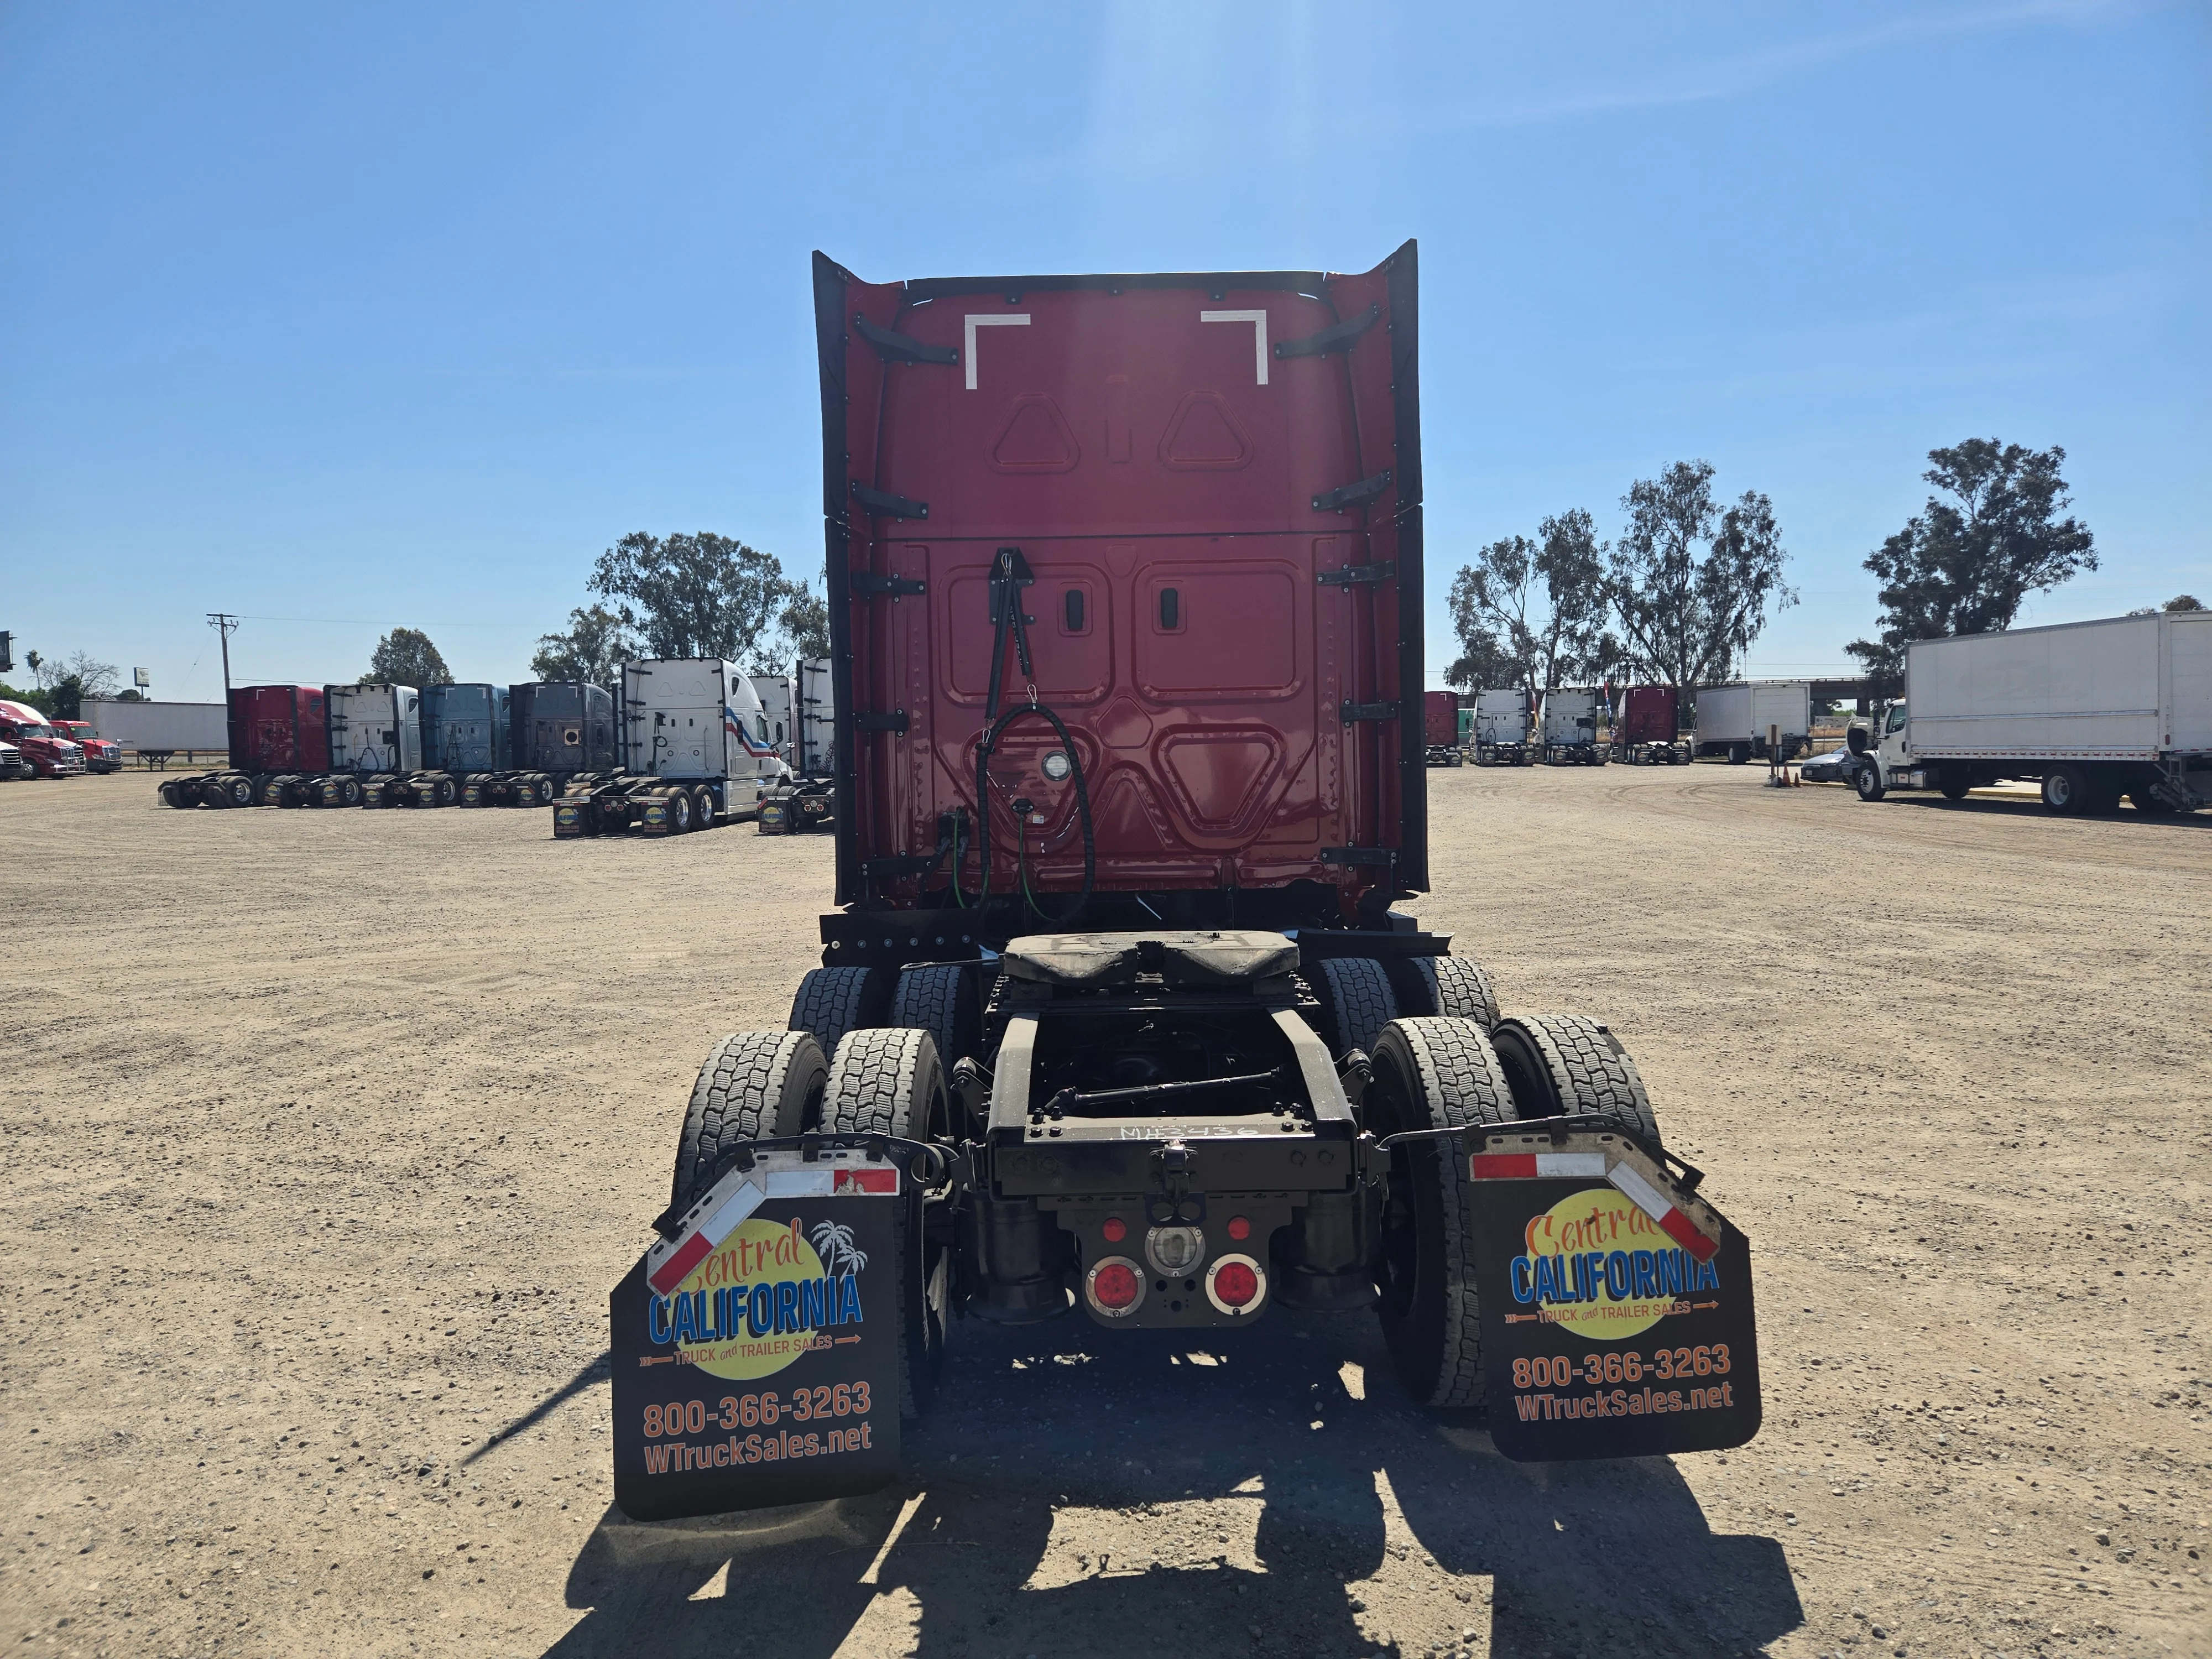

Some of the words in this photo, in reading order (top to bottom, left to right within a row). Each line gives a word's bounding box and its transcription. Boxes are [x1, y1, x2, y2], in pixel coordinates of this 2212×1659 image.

[1525, 1206, 1661, 1258] Centra
[1511, 1248, 1720, 1303] CALIFORNIA
[649, 1274, 863, 1345] CALIFORNIA
[1536, 1309, 1578, 1324] TRUCK
[1582, 1305, 1599, 1321] and
[1600, 1306, 1649, 1320] TRAILER
[1653, 1301, 1691, 1316] SALES
[675, 1348, 716, 1365] TRUCK
[720, 1343, 738, 1360] and
[739, 1340, 790, 1358] TRAILER
[793, 1335, 832, 1351] SALES
[1512, 1344, 1731, 1389] 800-366-3263
[643, 1381, 871, 1437] 800-366-3263
[1515, 1381, 1733, 1421] WTruckSales.net
[644, 1421, 872, 1474] WTruckSales.net
